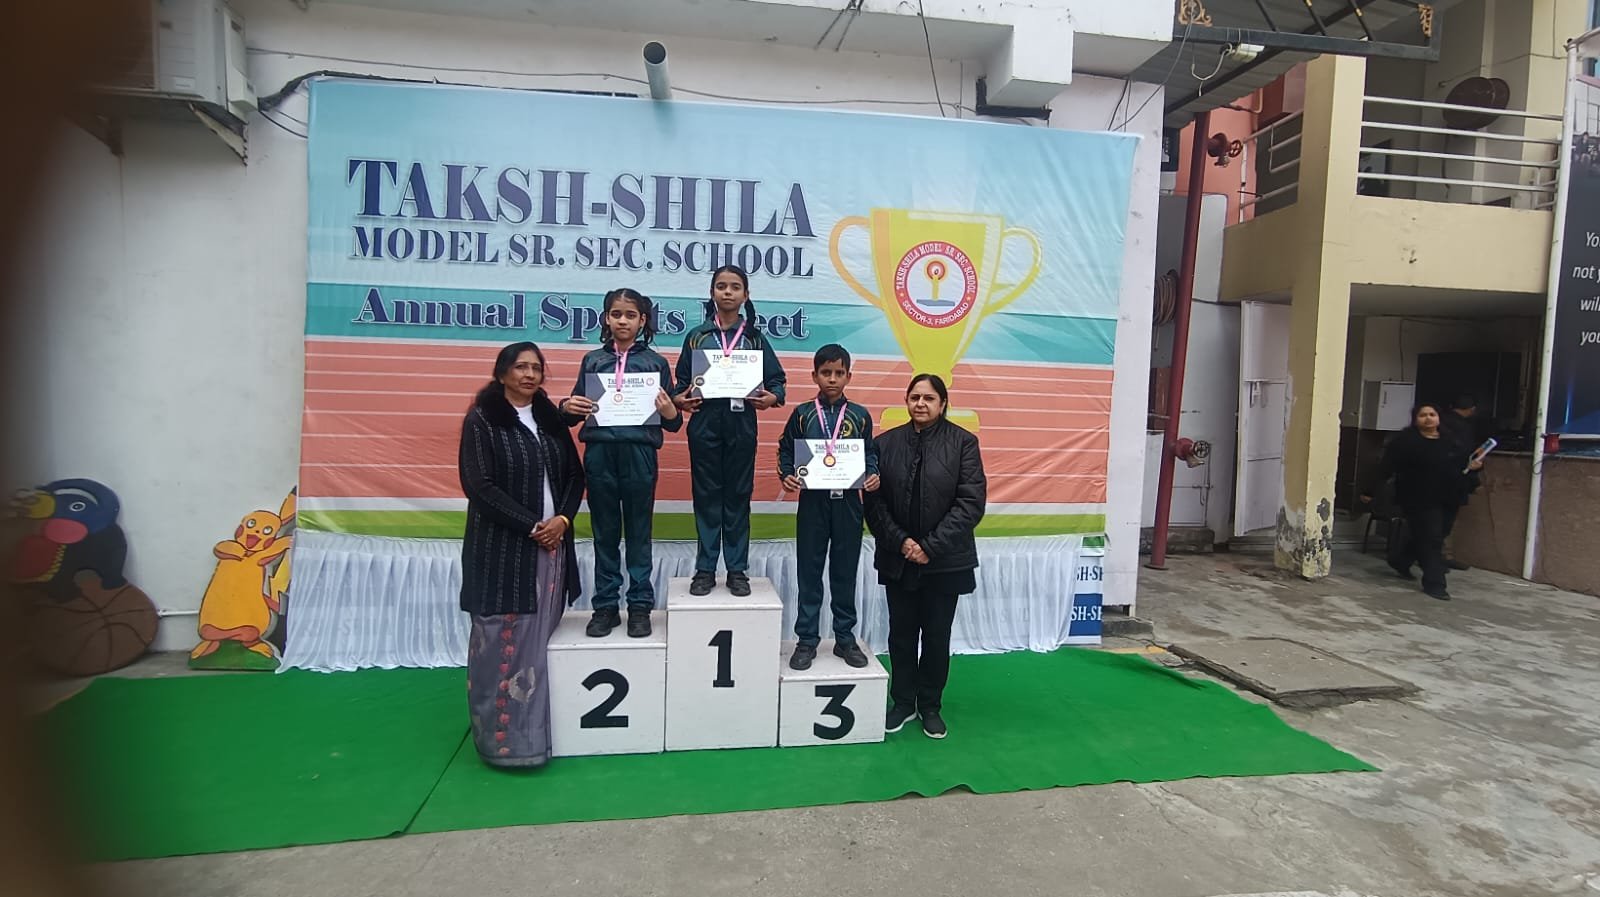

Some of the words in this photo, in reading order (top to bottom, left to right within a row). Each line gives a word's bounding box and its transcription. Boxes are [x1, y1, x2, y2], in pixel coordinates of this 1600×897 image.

[348, 159, 817, 238] TAKSH-SHILA
[352, 226, 500, 263] MODEL
[508, 233, 566, 267] SR.
[575, 236, 653, 269] SEC.
[663, 240, 814, 277] SCHOOL
[1584, 231, 1600, 248] Yo
[1572, 266, 1596, 279] not
[352, 287, 527, 330] Annual
[538, 293, 687, 342] Spts
[698, 299, 808, 341] eet
[934, 303, 968, 325] FARIDABAD
[708, 630, 735, 688] 1
[580, 668, 630, 729] 2
[814, 685, 856, 740] 3
